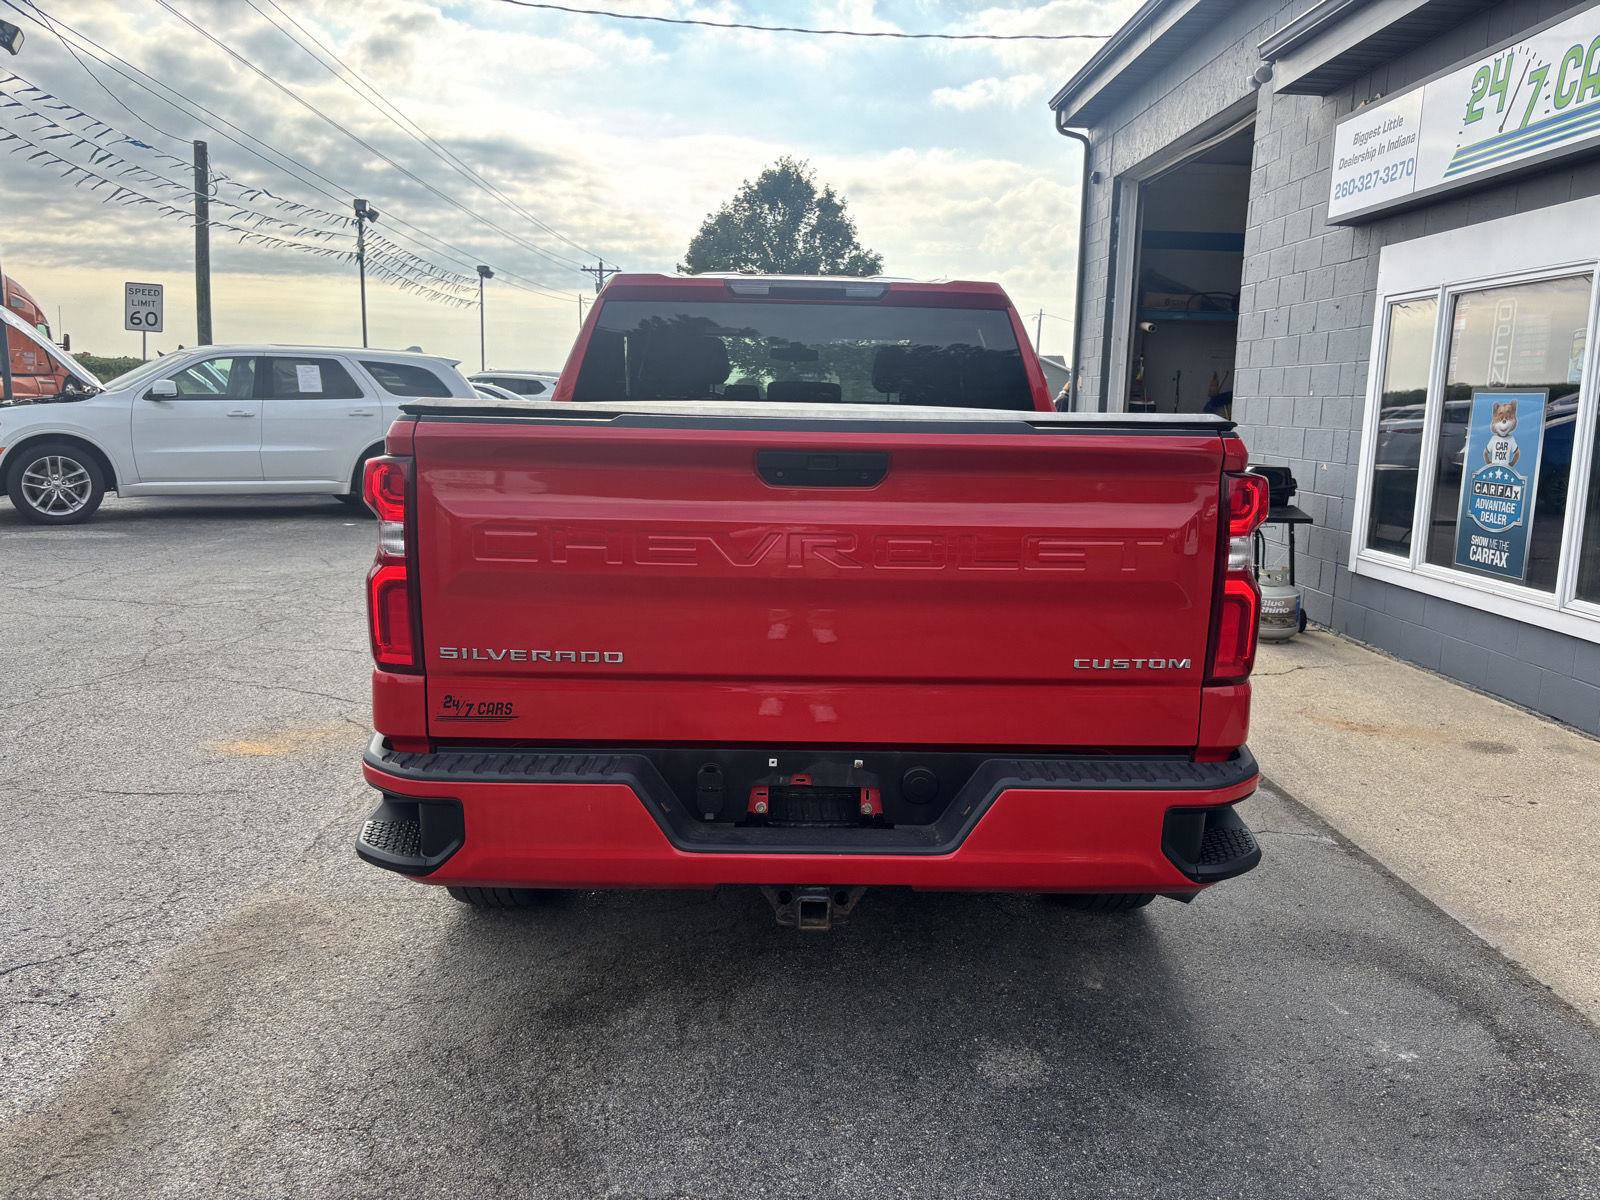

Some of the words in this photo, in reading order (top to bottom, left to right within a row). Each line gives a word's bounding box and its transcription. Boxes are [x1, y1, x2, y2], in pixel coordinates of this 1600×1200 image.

[1464, 52, 1551, 133] 24/7
[1353, 126, 1382, 146] Biggest
[1382, 115, 1404, 134] Little
[1338, 146, 1377, 170] Dealership
[1377, 142, 1386, 156] In
[1387, 133, 1416, 152] Indiana
[1334, 157, 1414, 200] 260-327-3270
[128, 287, 159, 296] SPEED
[131, 299, 157, 307] LIMIT
[130, 311, 158, 326] 60
[1491, 304, 1513, 383] OPEN
[1495, 441, 1508, 451] CAR
[1494, 451, 1507, 461] FOX
[1475, 482, 1519, 500] CARFAX
[1475, 497, 1515, 514] ADVANTAGE
[1480, 510, 1507, 526] DEALER
[472, 525, 1165, 571] CHEVROLET
[1470, 534, 1489, 547] SHOW
[1488, 538, 1499, 549] ME
[1499, 540, 1509, 552] THE
[1469, 545, 1508, 568] CARFAX
[439, 646, 624, 663] SILVERADO
[1073, 658, 1191, 669] CUSTOM
[443, 695, 474, 717] 24/7
[477, 702, 514, 716] CARS
